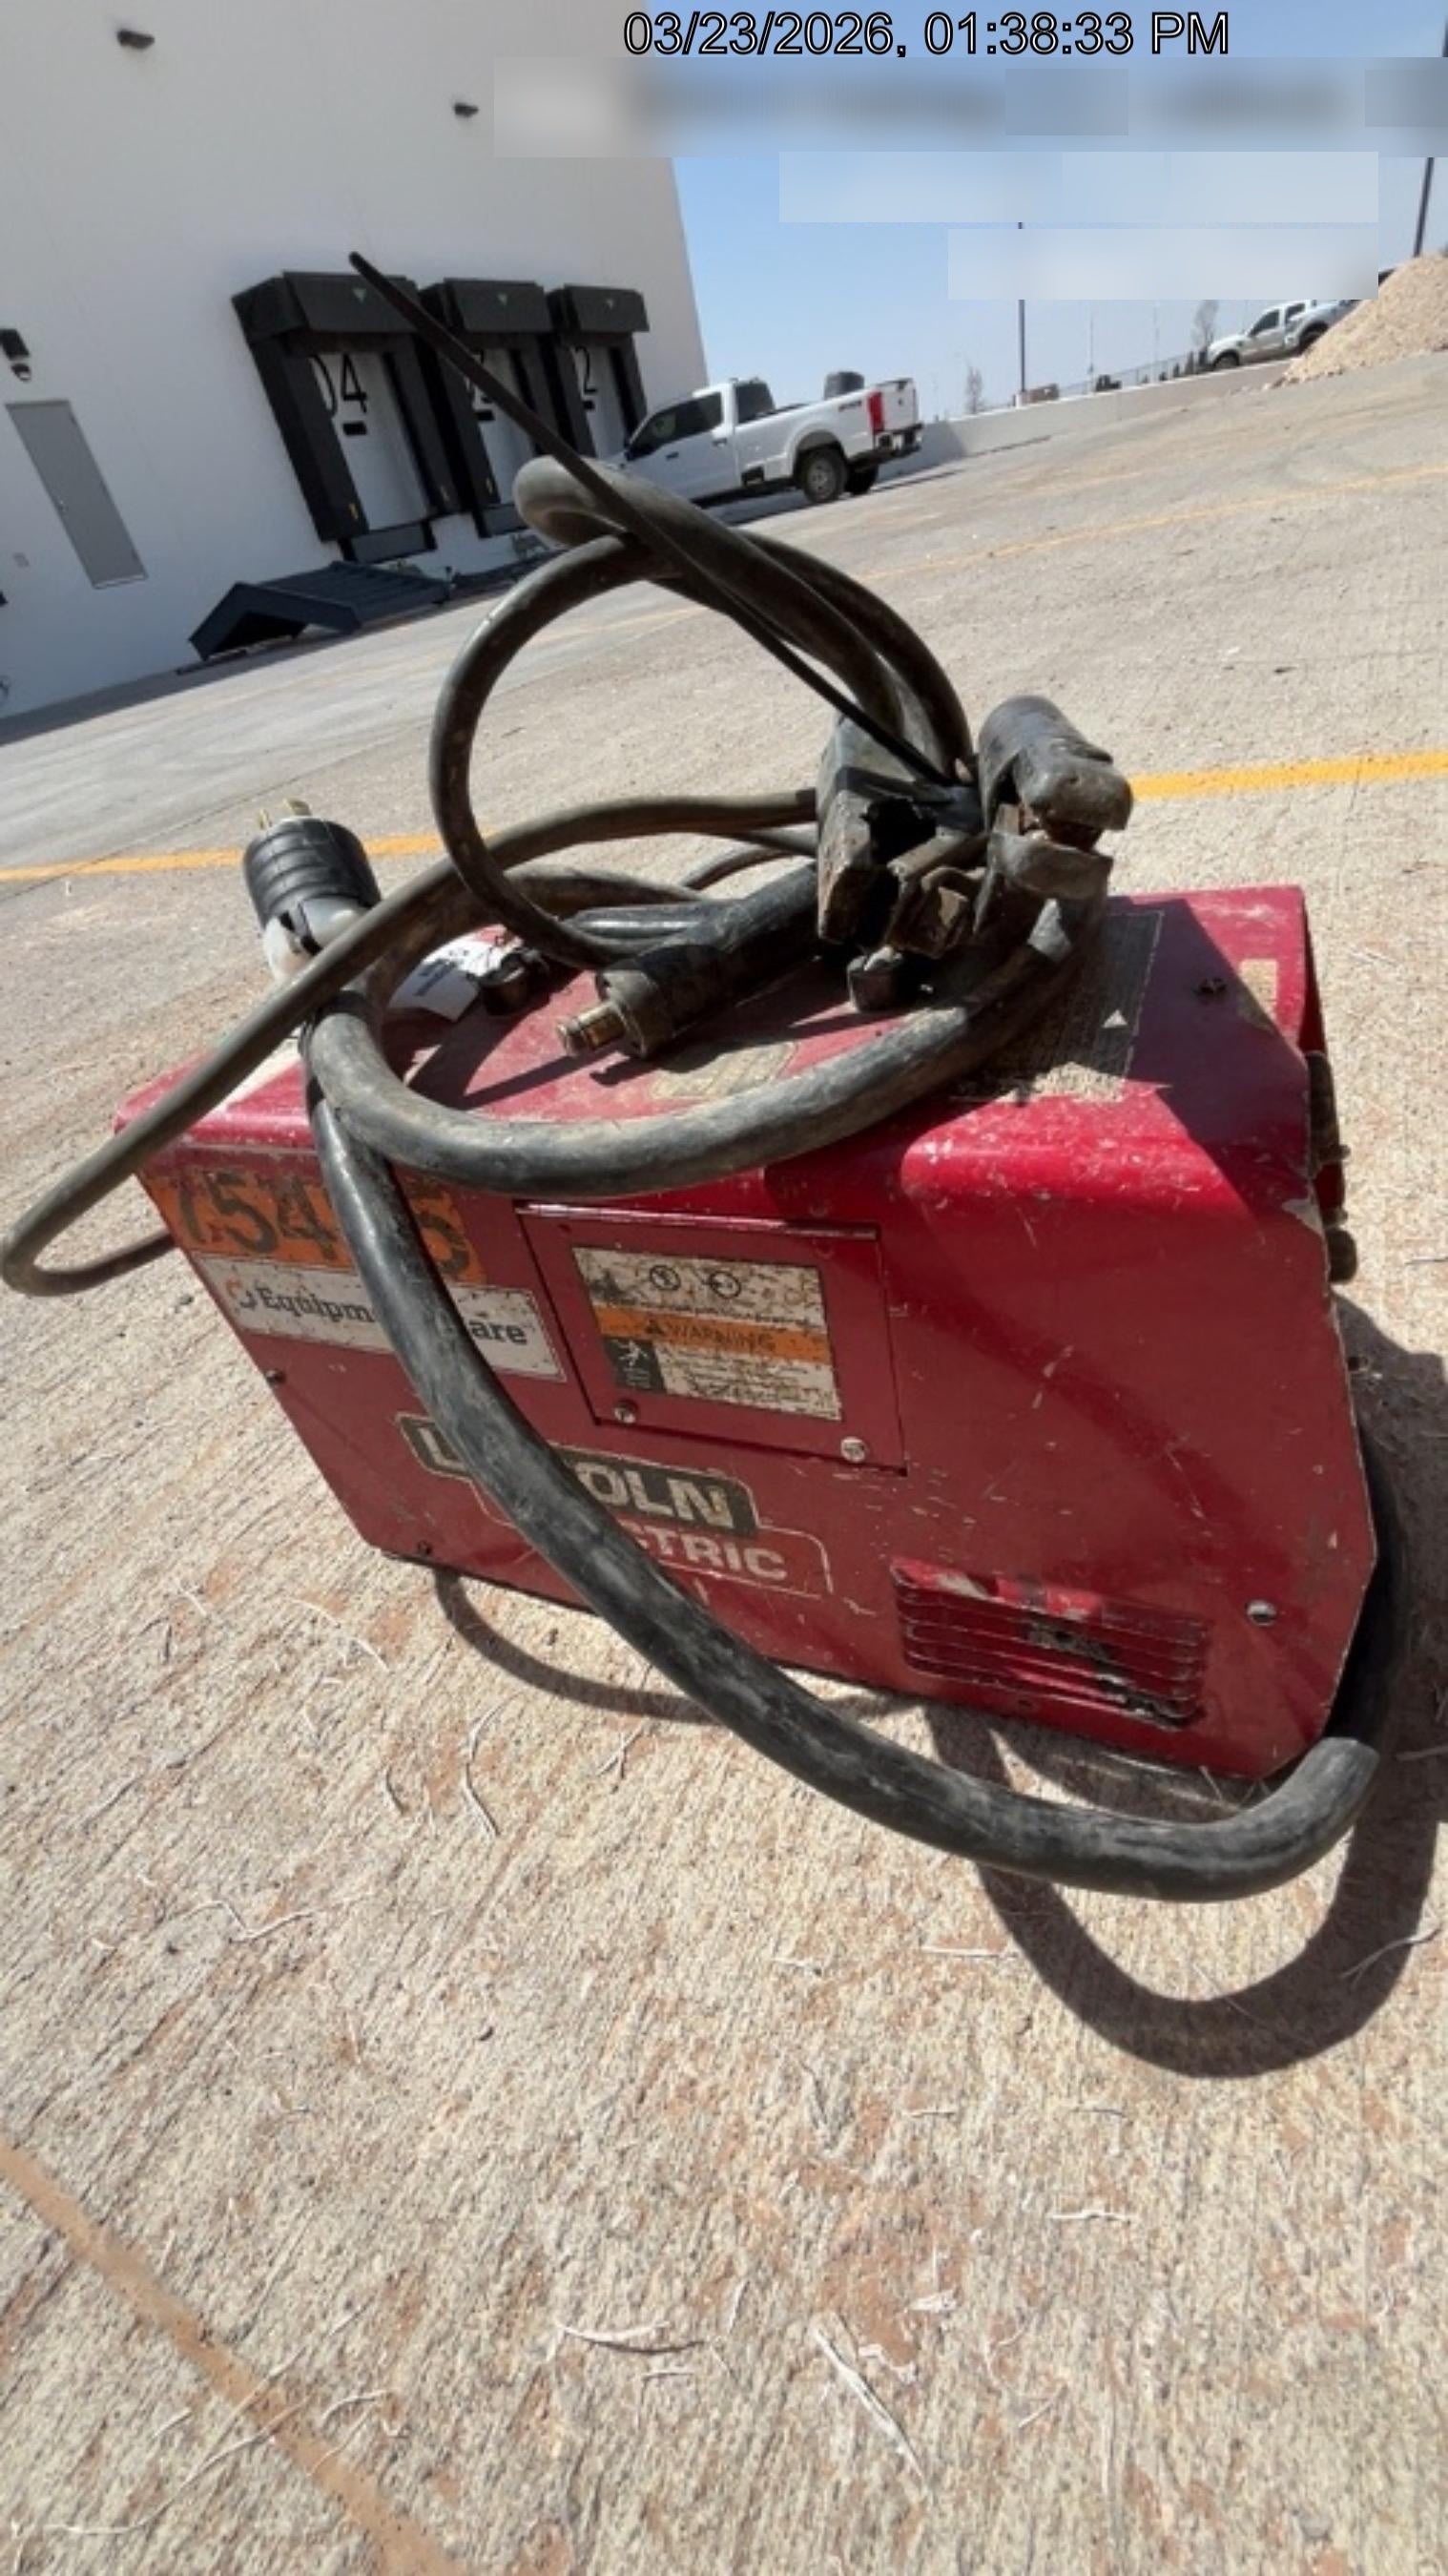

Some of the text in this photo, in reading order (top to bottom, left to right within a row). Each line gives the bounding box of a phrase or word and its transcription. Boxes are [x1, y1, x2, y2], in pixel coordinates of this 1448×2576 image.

[158, 1170, 470, 1277] 7545
[258, 1285, 527, 1345] Equipmare
[417, 1426, 734, 1528] LOLN
